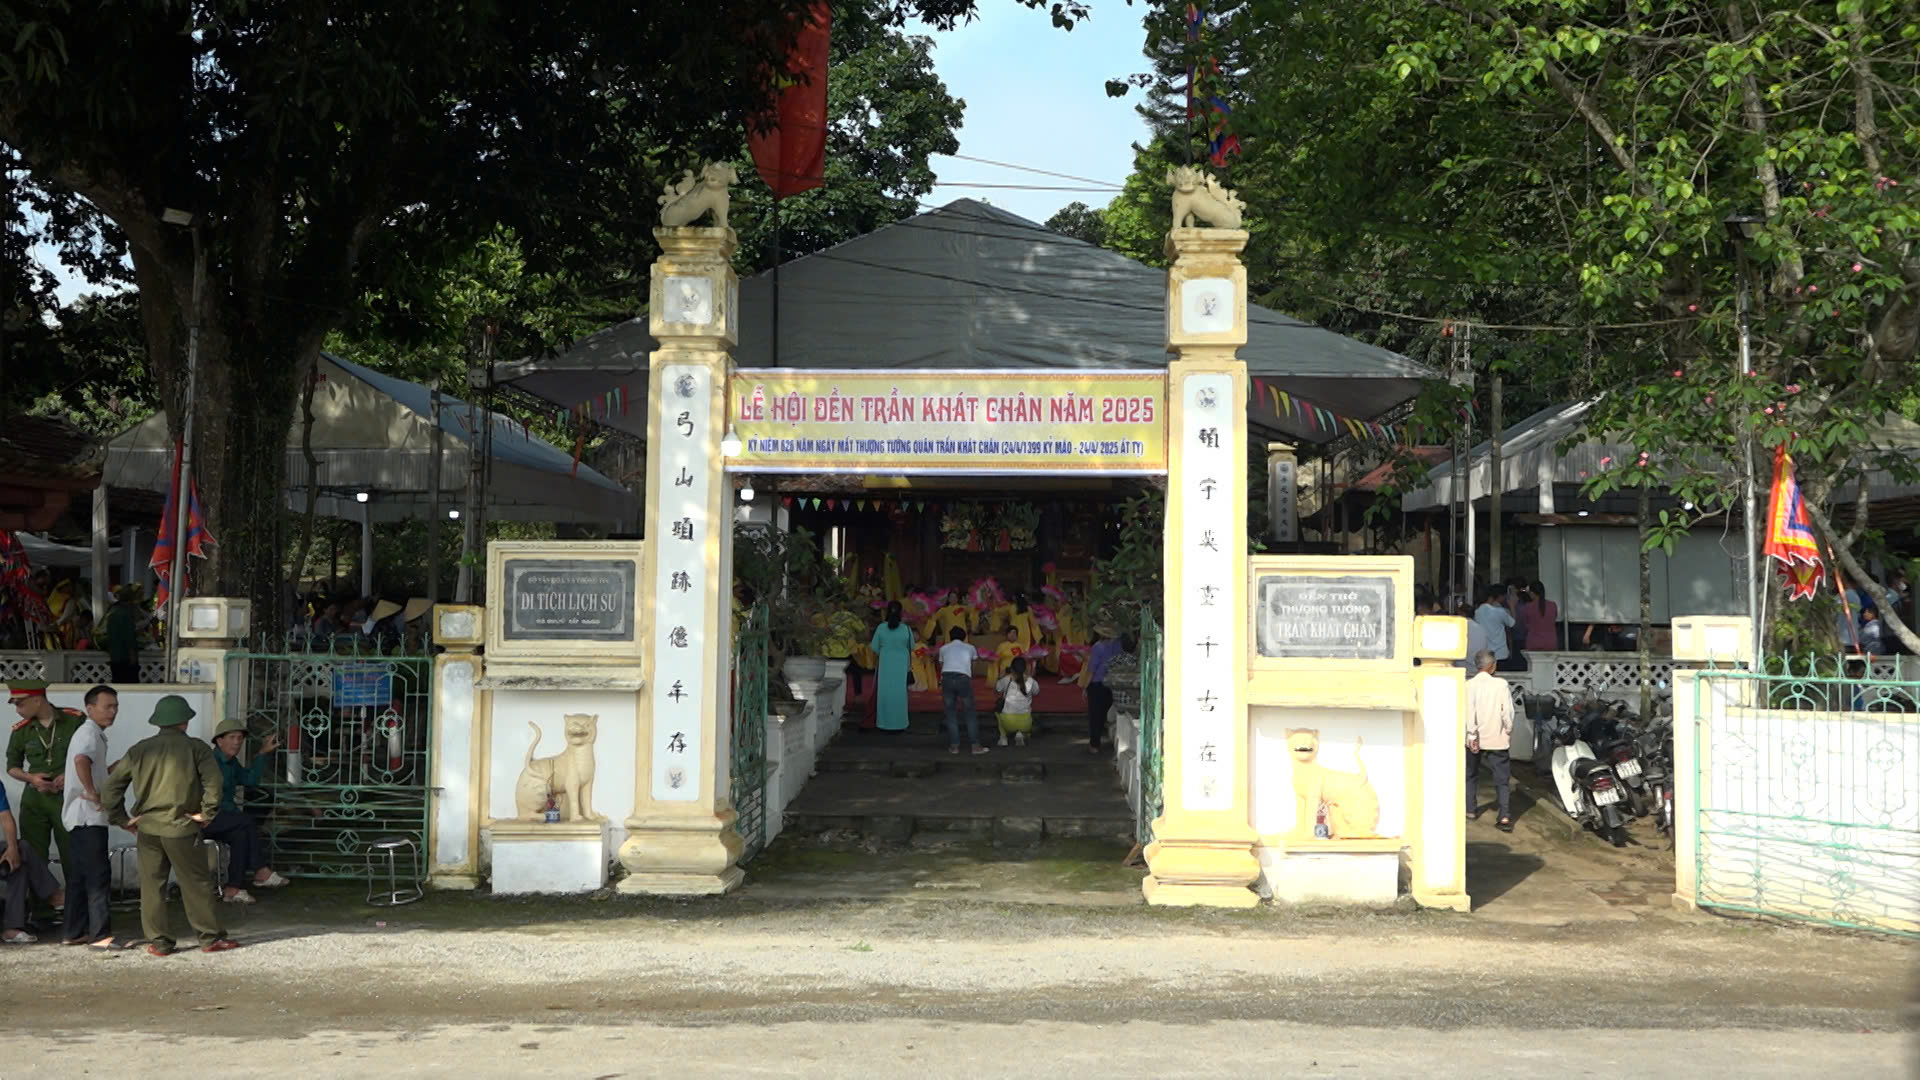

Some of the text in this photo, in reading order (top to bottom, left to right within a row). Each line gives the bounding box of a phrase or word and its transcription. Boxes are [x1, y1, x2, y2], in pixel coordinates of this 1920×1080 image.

[740, 384, 1154, 427] LỄ HỘI ĐỀN TRẦN KHÁT CHÂN NĂM 2025
[760, 437, 779, 455] NIỆM
[781, 439, 795, 452] 626
[796, 437, 814, 452] NĂM
[837, 436, 854, 453] MẤT
[856, 439, 885, 455] THƯỢNG
[913, 437, 934, 454] QUÂN
[957, 437, 976, 454] KHÁT
[978, 437, 999, 454] CHÂN
[521, 593, 534, 610] DI
[568, 592, 597, 616] LỊCH
